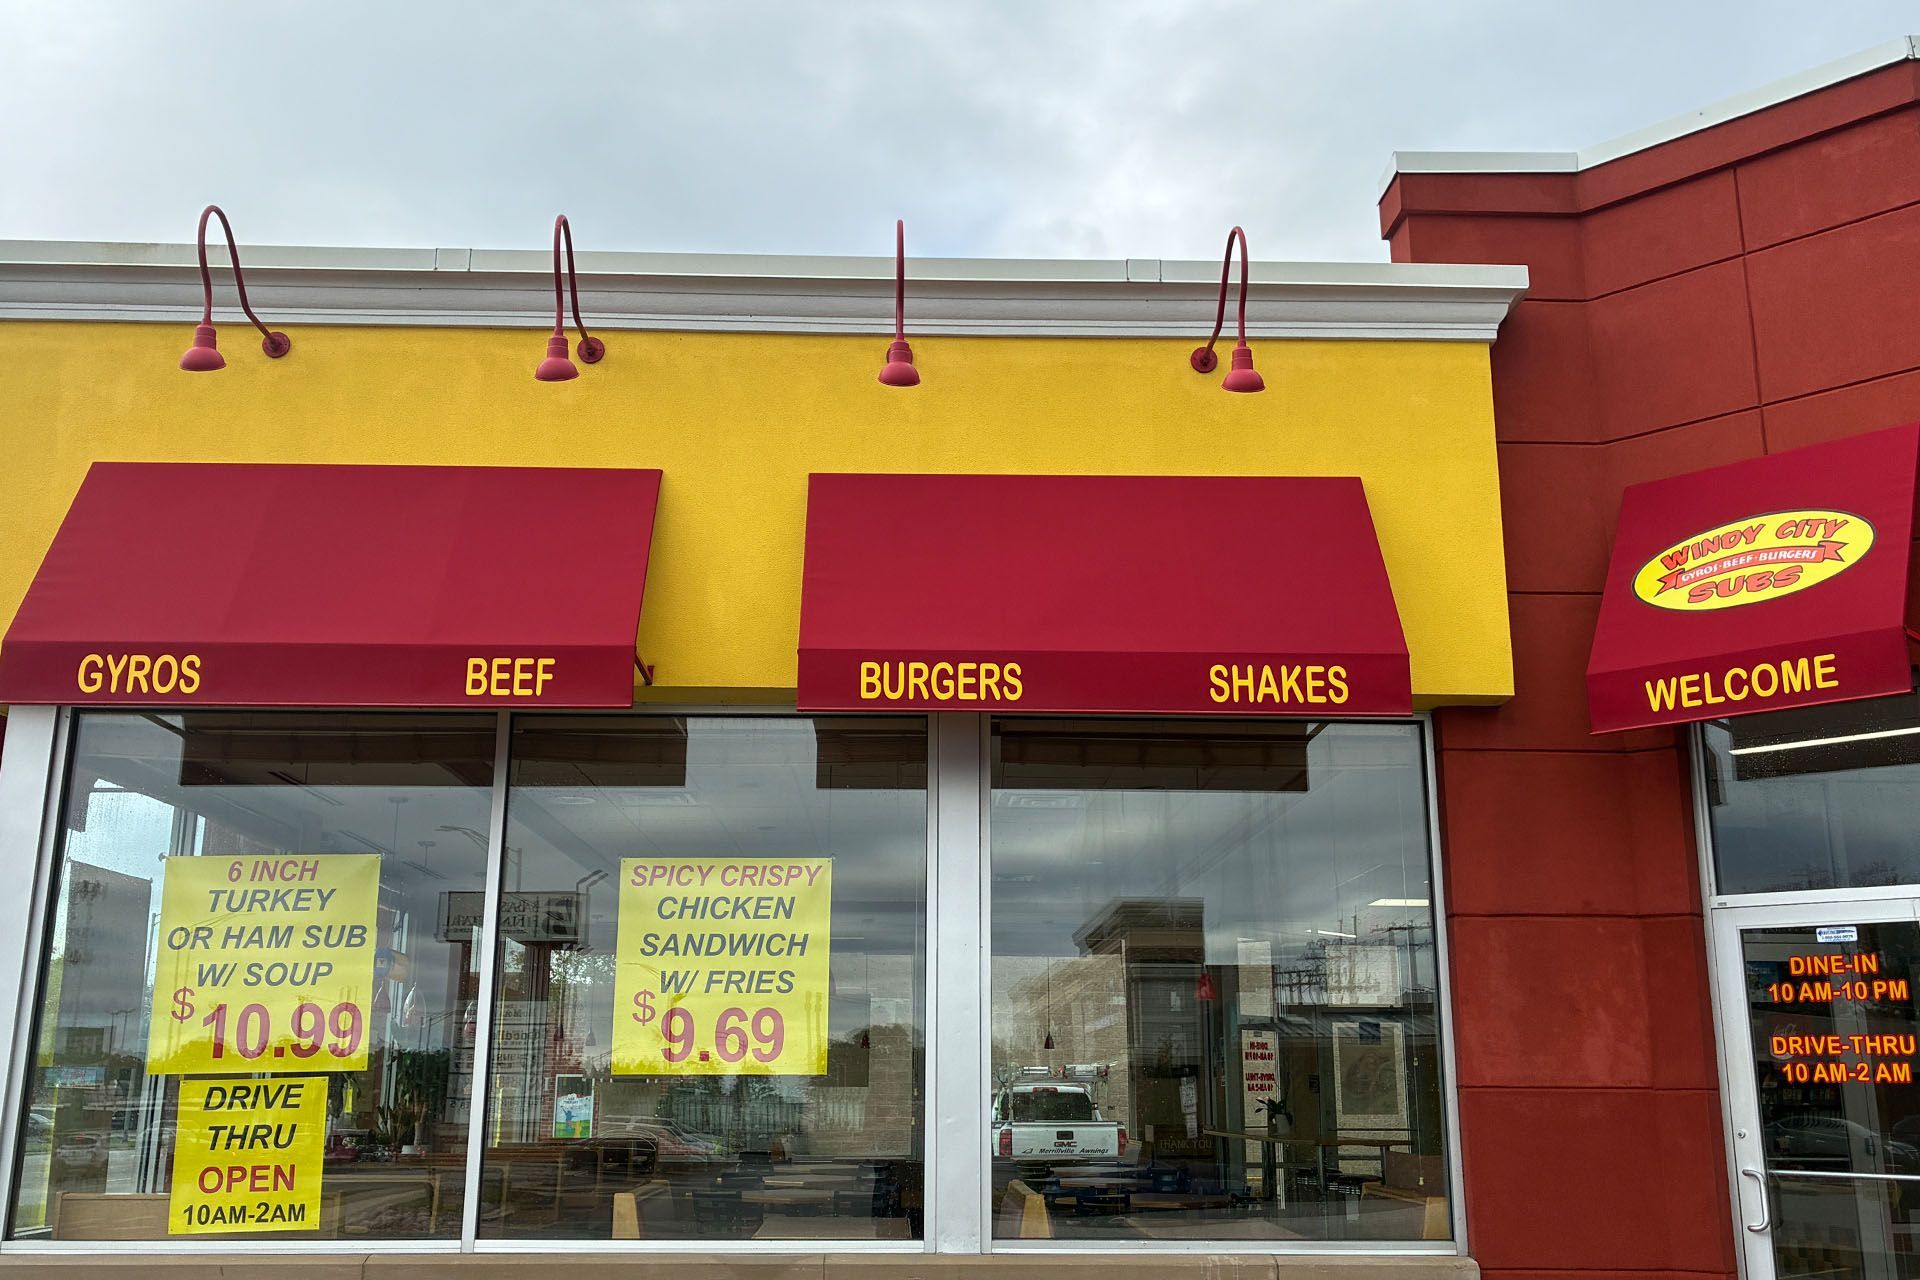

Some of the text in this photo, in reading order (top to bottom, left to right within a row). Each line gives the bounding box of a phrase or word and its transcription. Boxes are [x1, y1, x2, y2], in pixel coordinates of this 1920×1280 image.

[1660, 518, 1849, 571] WINDY CITY
[1723, 554, 1753, 568] BEEF
[1759, 549, 1818, 561] BURGERS
[1687, 565, 1803, 603] SUBS
[78, 654, 201, 694] GYROS
[465, 657, 556, 697] BEEF
[860, 661, 1023, 701] BURGERS
[1209, 664, 1349, 704] SHAKES
[1645, 653, 1839, 713] WELCOME
[227, 860, 320, 882] 6 INCH
[631, 864, 823, 887] SPICY CRISPY
[208, 888, 337, 913] TURKEY
[657, 896, 796, 920] CHICKEN
[167, 925, 368, 950] OR HAM SUB
[640, 933, 809, 957] SANDWICH
[197, 962, 333, 987] W/ SOUP
[1789, 953, 1880, 976] DINE-IN
[660, 970, 796, 994] W/ FRIES
[1768, 980, 1910, 1003] 10 AM-10 PM
[1772, 1035, 1917, 1056] DRIVE-THRU
[1782, 1063, 1912, 1084] 10 AM-2 AM
[203, 1084, 304, 1111] DRIVE
[208, 1123, 297, 1151] THRU
[1192, 1139, 1212, 1150] YOU
[198, 1164, 296, 1194] OPEN
[183, 1202, 306, 1226] 10AM-2AM
